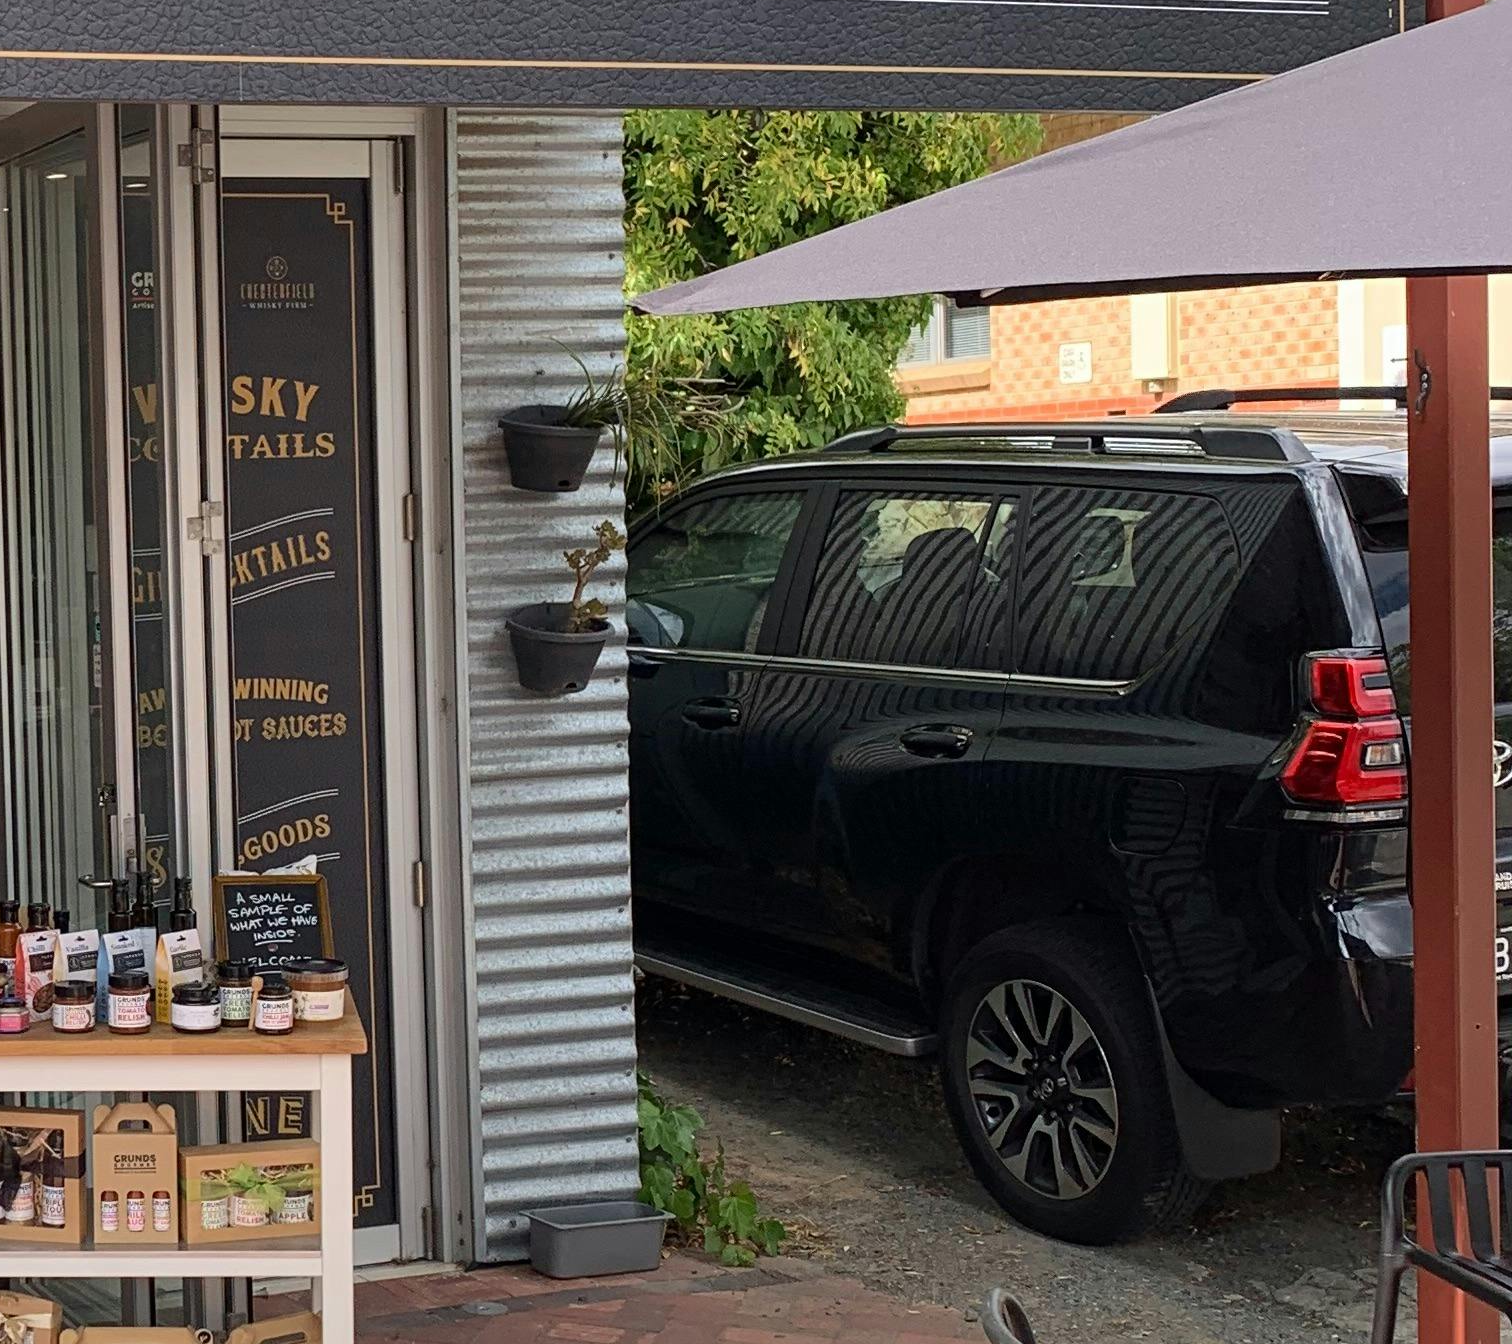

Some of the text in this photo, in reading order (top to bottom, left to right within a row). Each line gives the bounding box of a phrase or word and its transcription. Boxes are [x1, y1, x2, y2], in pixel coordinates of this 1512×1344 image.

[240, 283, 315, 299] CHESTERFIELD
[231, 375, 320, 423] SKY
[228, 432, 337, 460] TAILS
[261, 712, 348, 742] SAUCES
[238, 813, 332, 866] GOODS
[236, 892, 295, 905] A SMALL
[228, 903, 313, 918] SAMPLE OF
[230, 915, 318, 931] WHAT WE HAVE
[117, 1014, 146, 1022] RELISH
[246, 1096, 304, 1136] NE
[114, 1154, 157, 1163] GRUNDS
